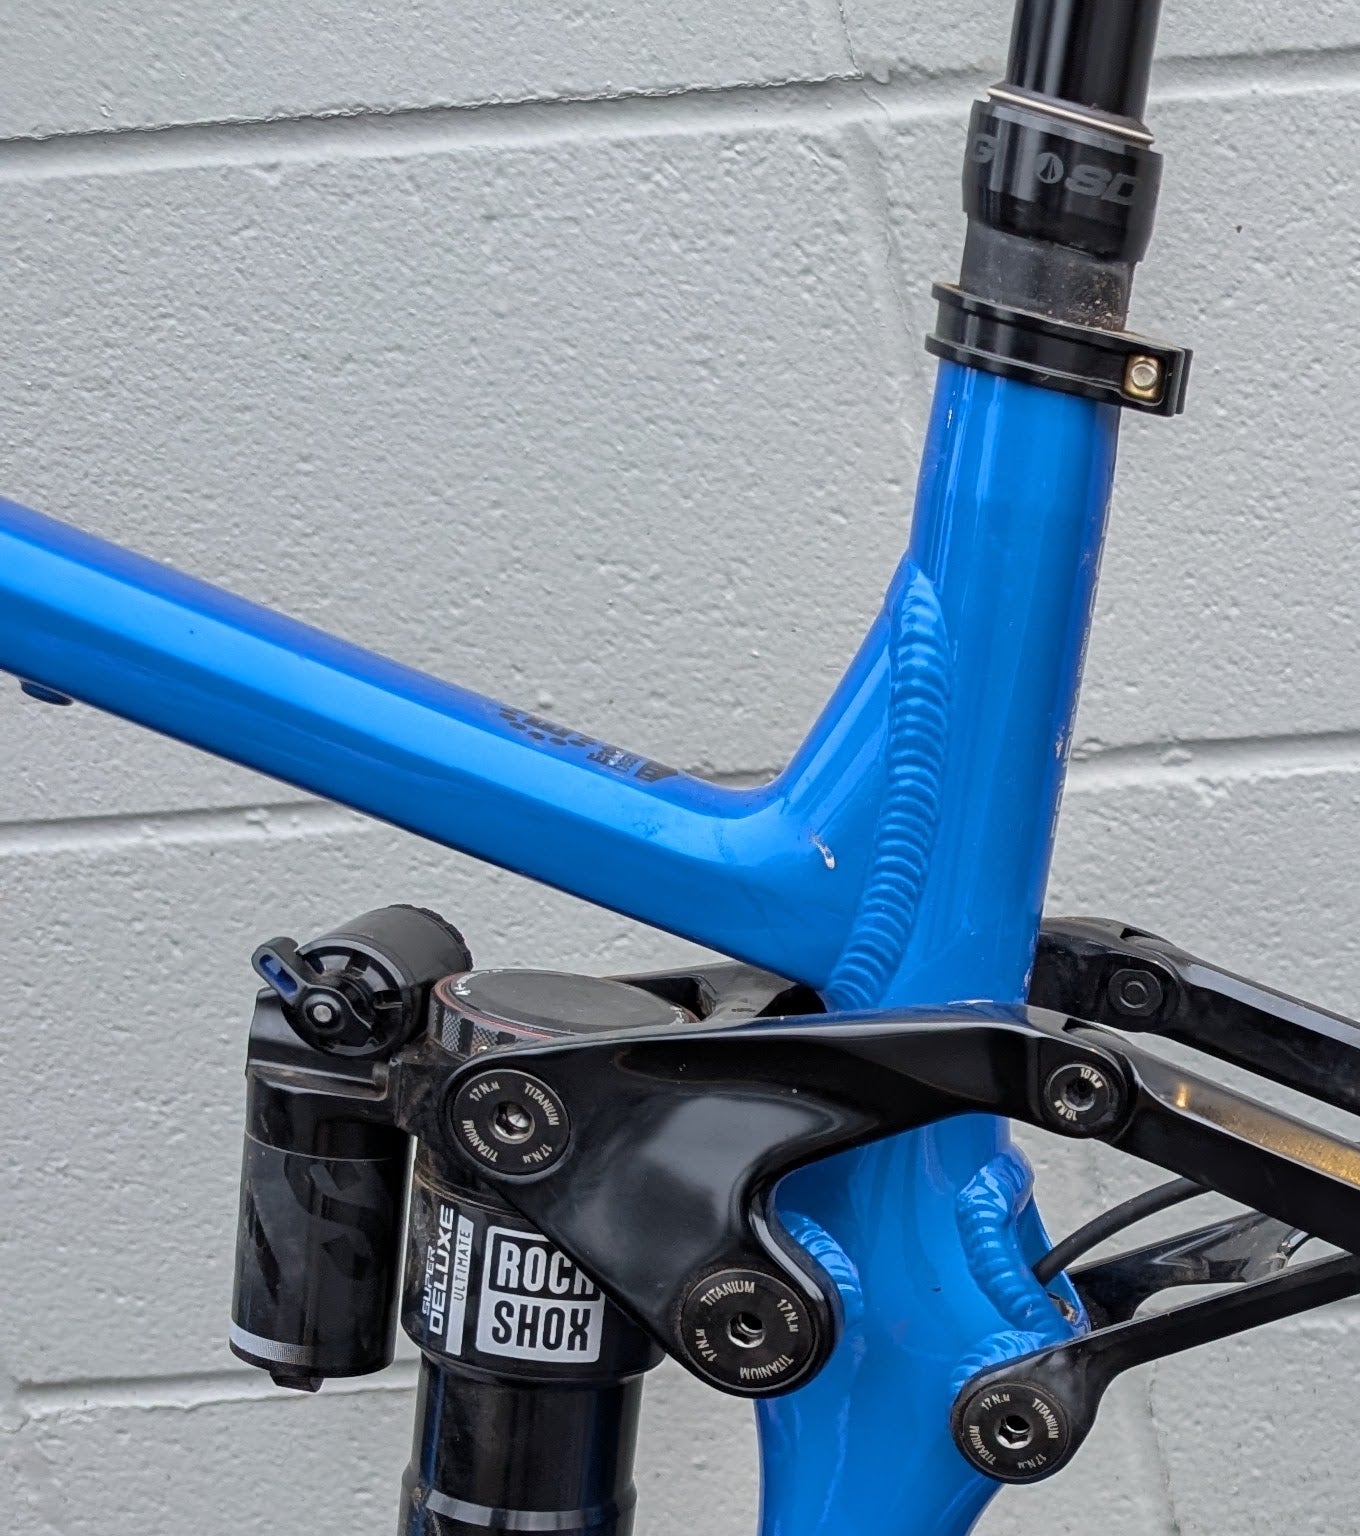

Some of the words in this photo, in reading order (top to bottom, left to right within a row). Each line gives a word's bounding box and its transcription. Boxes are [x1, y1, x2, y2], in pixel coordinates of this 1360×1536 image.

[1065, 164, 1142, 206] SD
[525, 1082, 560, 1126] TITANIUM
[462, 1119, 498, 1163] TITANIUM
[422, 1245, 437, 1316] SUPER
[429, 1204, 455, 1336] DELUXE
[453, 1229, 471, 1302] ULTIMATE
[700, 1280, 755, 1306] TITANIUM
[491, 1300, 592, 1352] SHOX
[739, 1354, 795, 1380] TITANIUM
[1032, 1397, 1060, 1439] TITANIUM
[969, 1424, 997, 1466] TITANIUM
